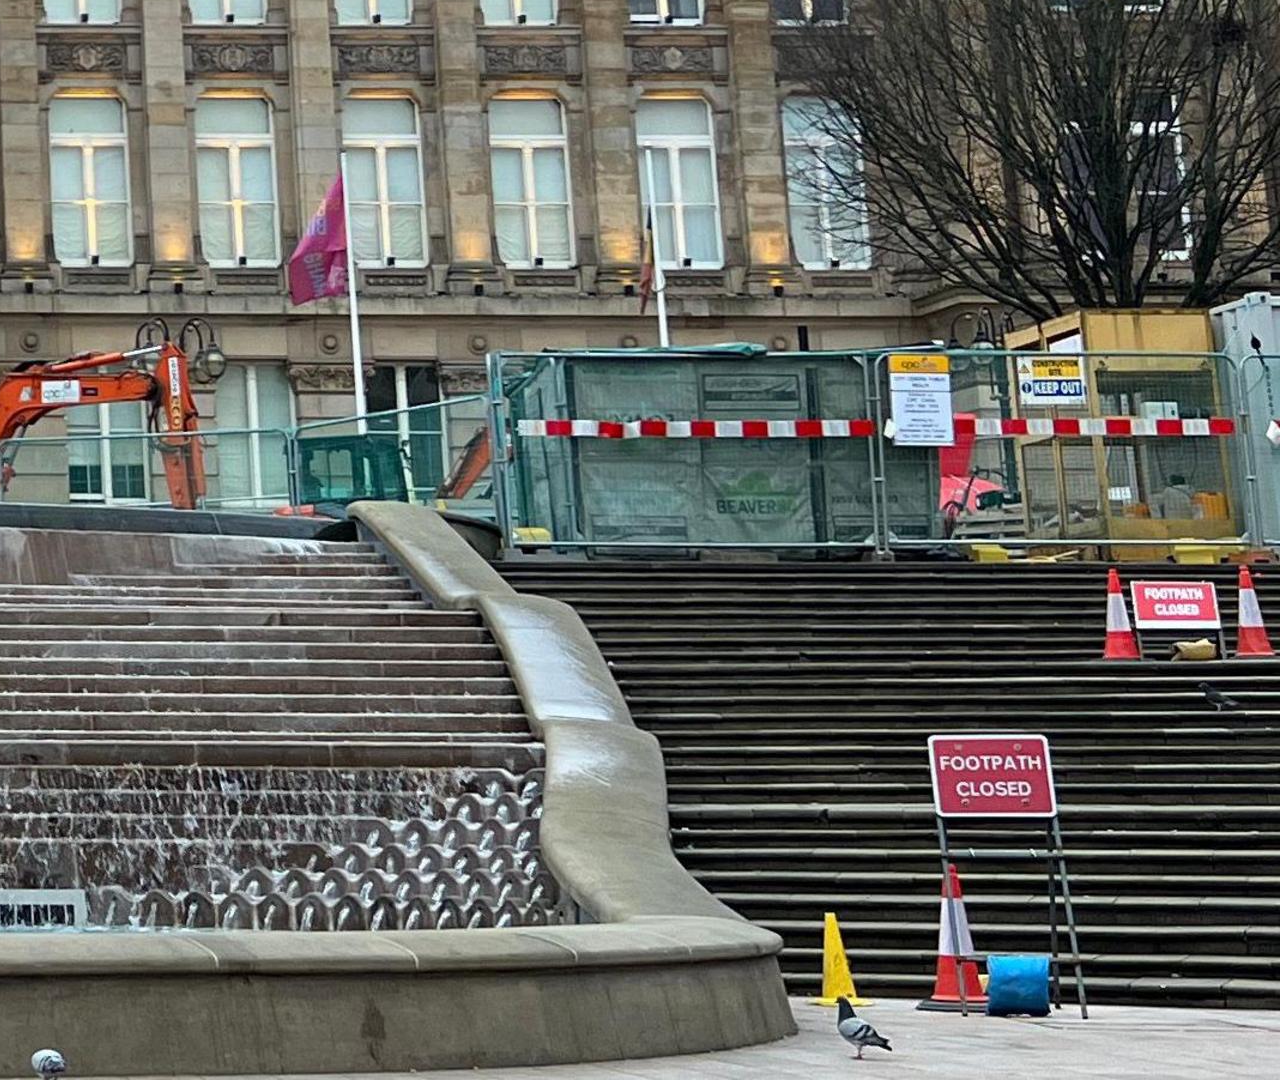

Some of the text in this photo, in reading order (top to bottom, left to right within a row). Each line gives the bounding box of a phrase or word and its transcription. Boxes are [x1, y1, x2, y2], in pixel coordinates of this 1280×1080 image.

[1034, 381, 1081, 395] KEEP OUT
[1144, 587, 1204, 600] FOOTPATH
[1153, 602, 1200, 616] CLOSED
[940, 755, 1042, 771] FOOTPATH
[956, 781, 1032, 797] CLOSED
